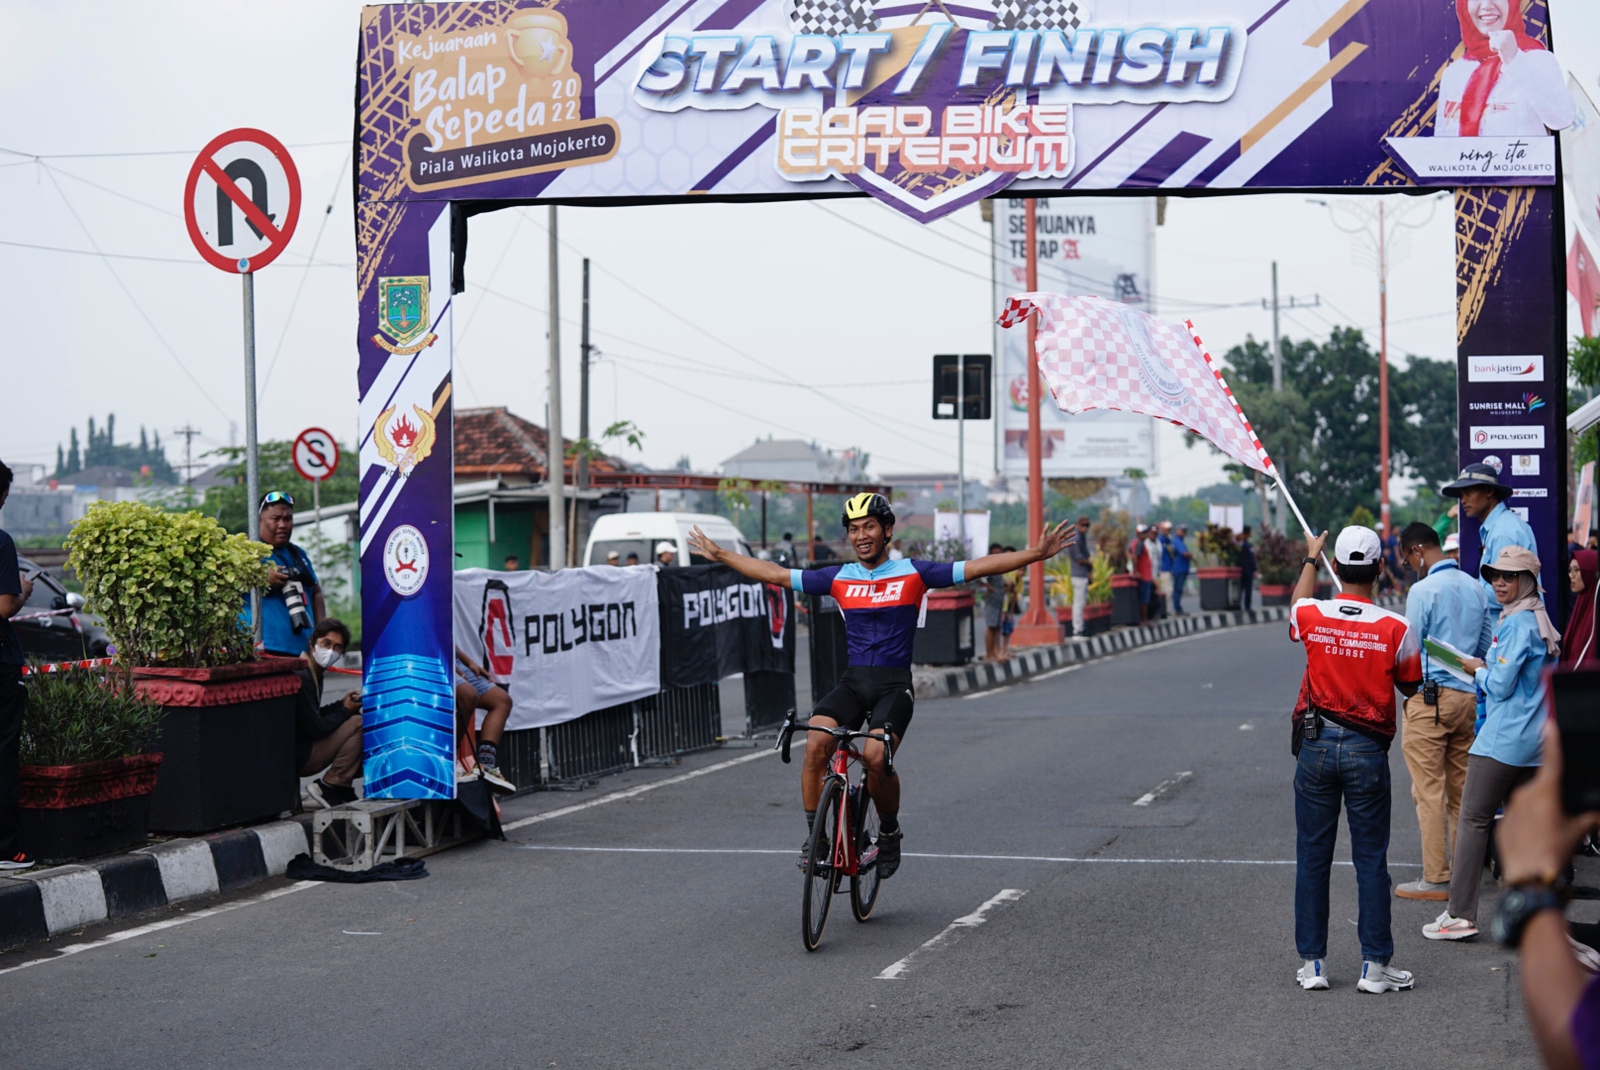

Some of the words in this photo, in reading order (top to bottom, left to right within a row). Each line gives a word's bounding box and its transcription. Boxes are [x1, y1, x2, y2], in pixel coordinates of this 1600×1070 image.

[397, 30, 498, 65] Kejuaraan
[637, 33, 892, 92] START
[957, 26, 1231, 88] FINISH
[413, 56, 506, 112] Balap
[552, 78, 577, 99] 20
[423, 84, 545, 152] Sepeda
[552, 100, 577, 122] 22
[784, 106, 932, 136] ROAD
[946, 104, 1067, 134] BIKE
[420, 160, 455, 176] Piala
[460, 143, 524, 169] Walikota
[530, 134, 606, 158] Mojokerto
[783, 135, 1070, 167] CRITERIUM
[1459, 149, 1499, 172] ning
[1505, 140, 1529, 163] ita
[1010, 239, 1058, 258] TEAP
[394, 338, 430, 354] MOJOKERTO
[1474, 364, 1522, 374] bankjatim
[1469, 402, 1503, 410] SUNRISE
[1505, 402, 1526, 410] MALL
[845, 580, 906, 597] MLA
[871, 593, 901, 603] RACING
[683, 583, 766, 629] POLYGON
[525, 601, 637, 657] POLYGON
[1347, 631, 1359, 639] ISSI
[1308, 633, 1337, 645] REGIONAL
[1339, 638, 1387, 652] COMMISSAIRE
[1325, 645, 1364, 659] COURSE
